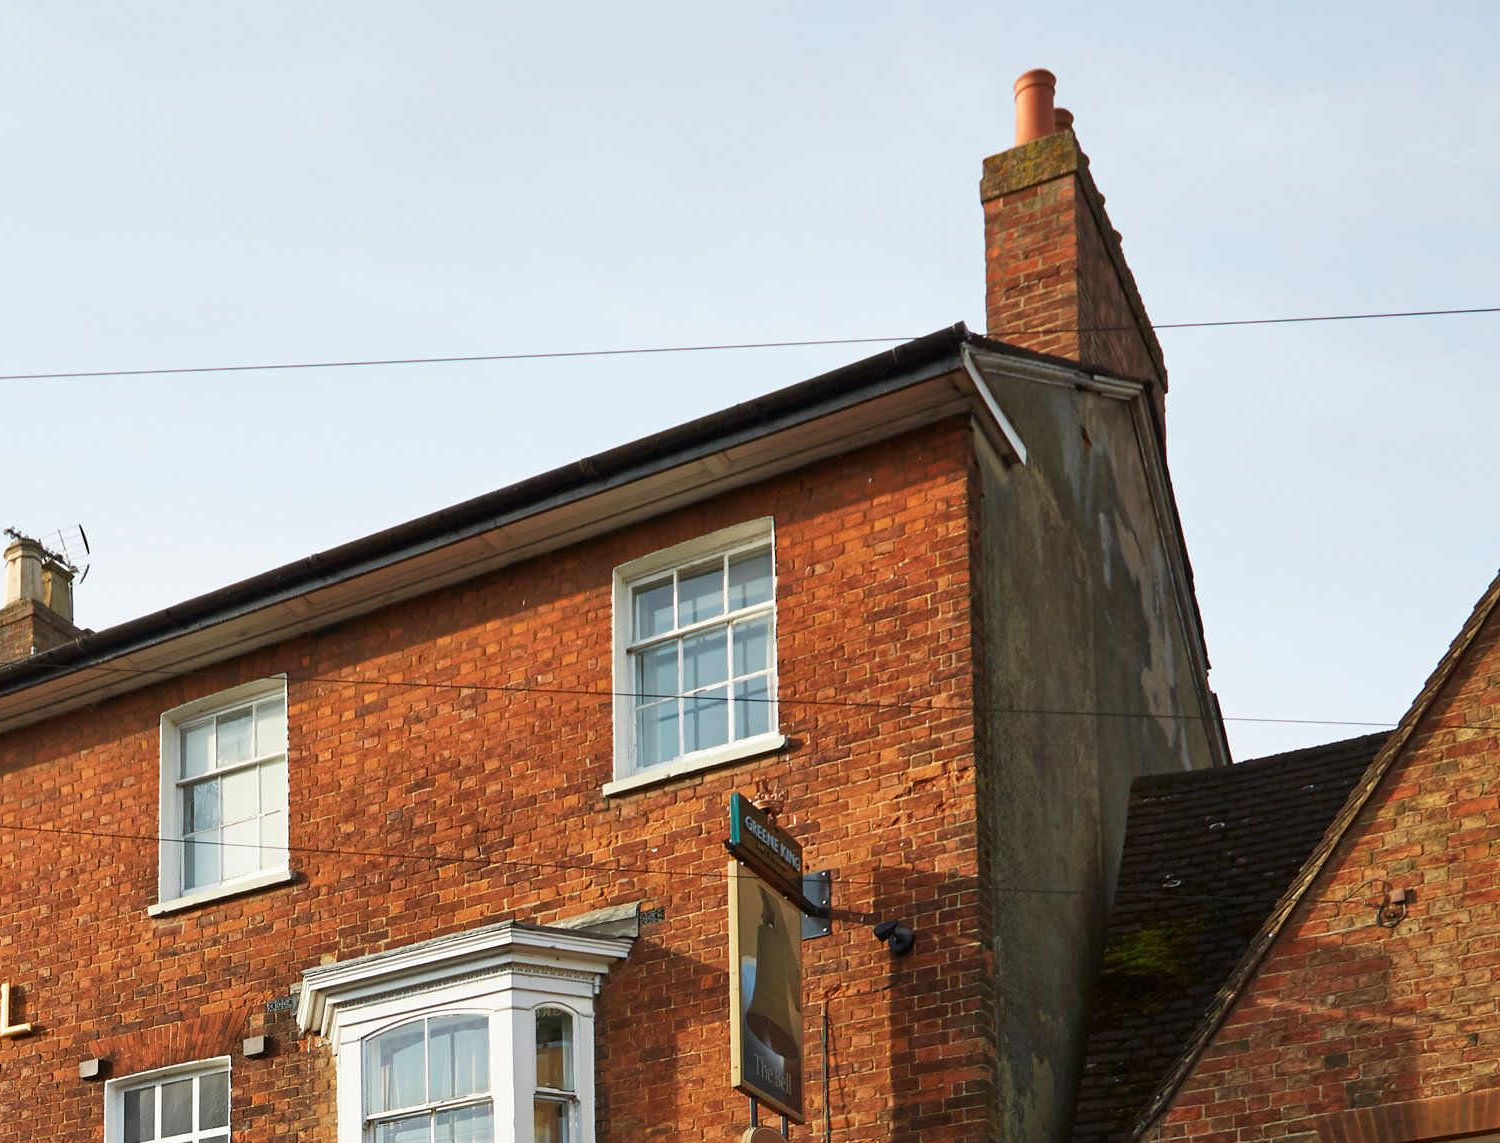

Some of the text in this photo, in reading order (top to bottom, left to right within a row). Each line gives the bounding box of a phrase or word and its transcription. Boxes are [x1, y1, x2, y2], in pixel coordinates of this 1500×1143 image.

[744, 815, 780, 853] GREENE
[780, 843, 801, 872] KING
[753, 1053, 792, 1096] The Bell
